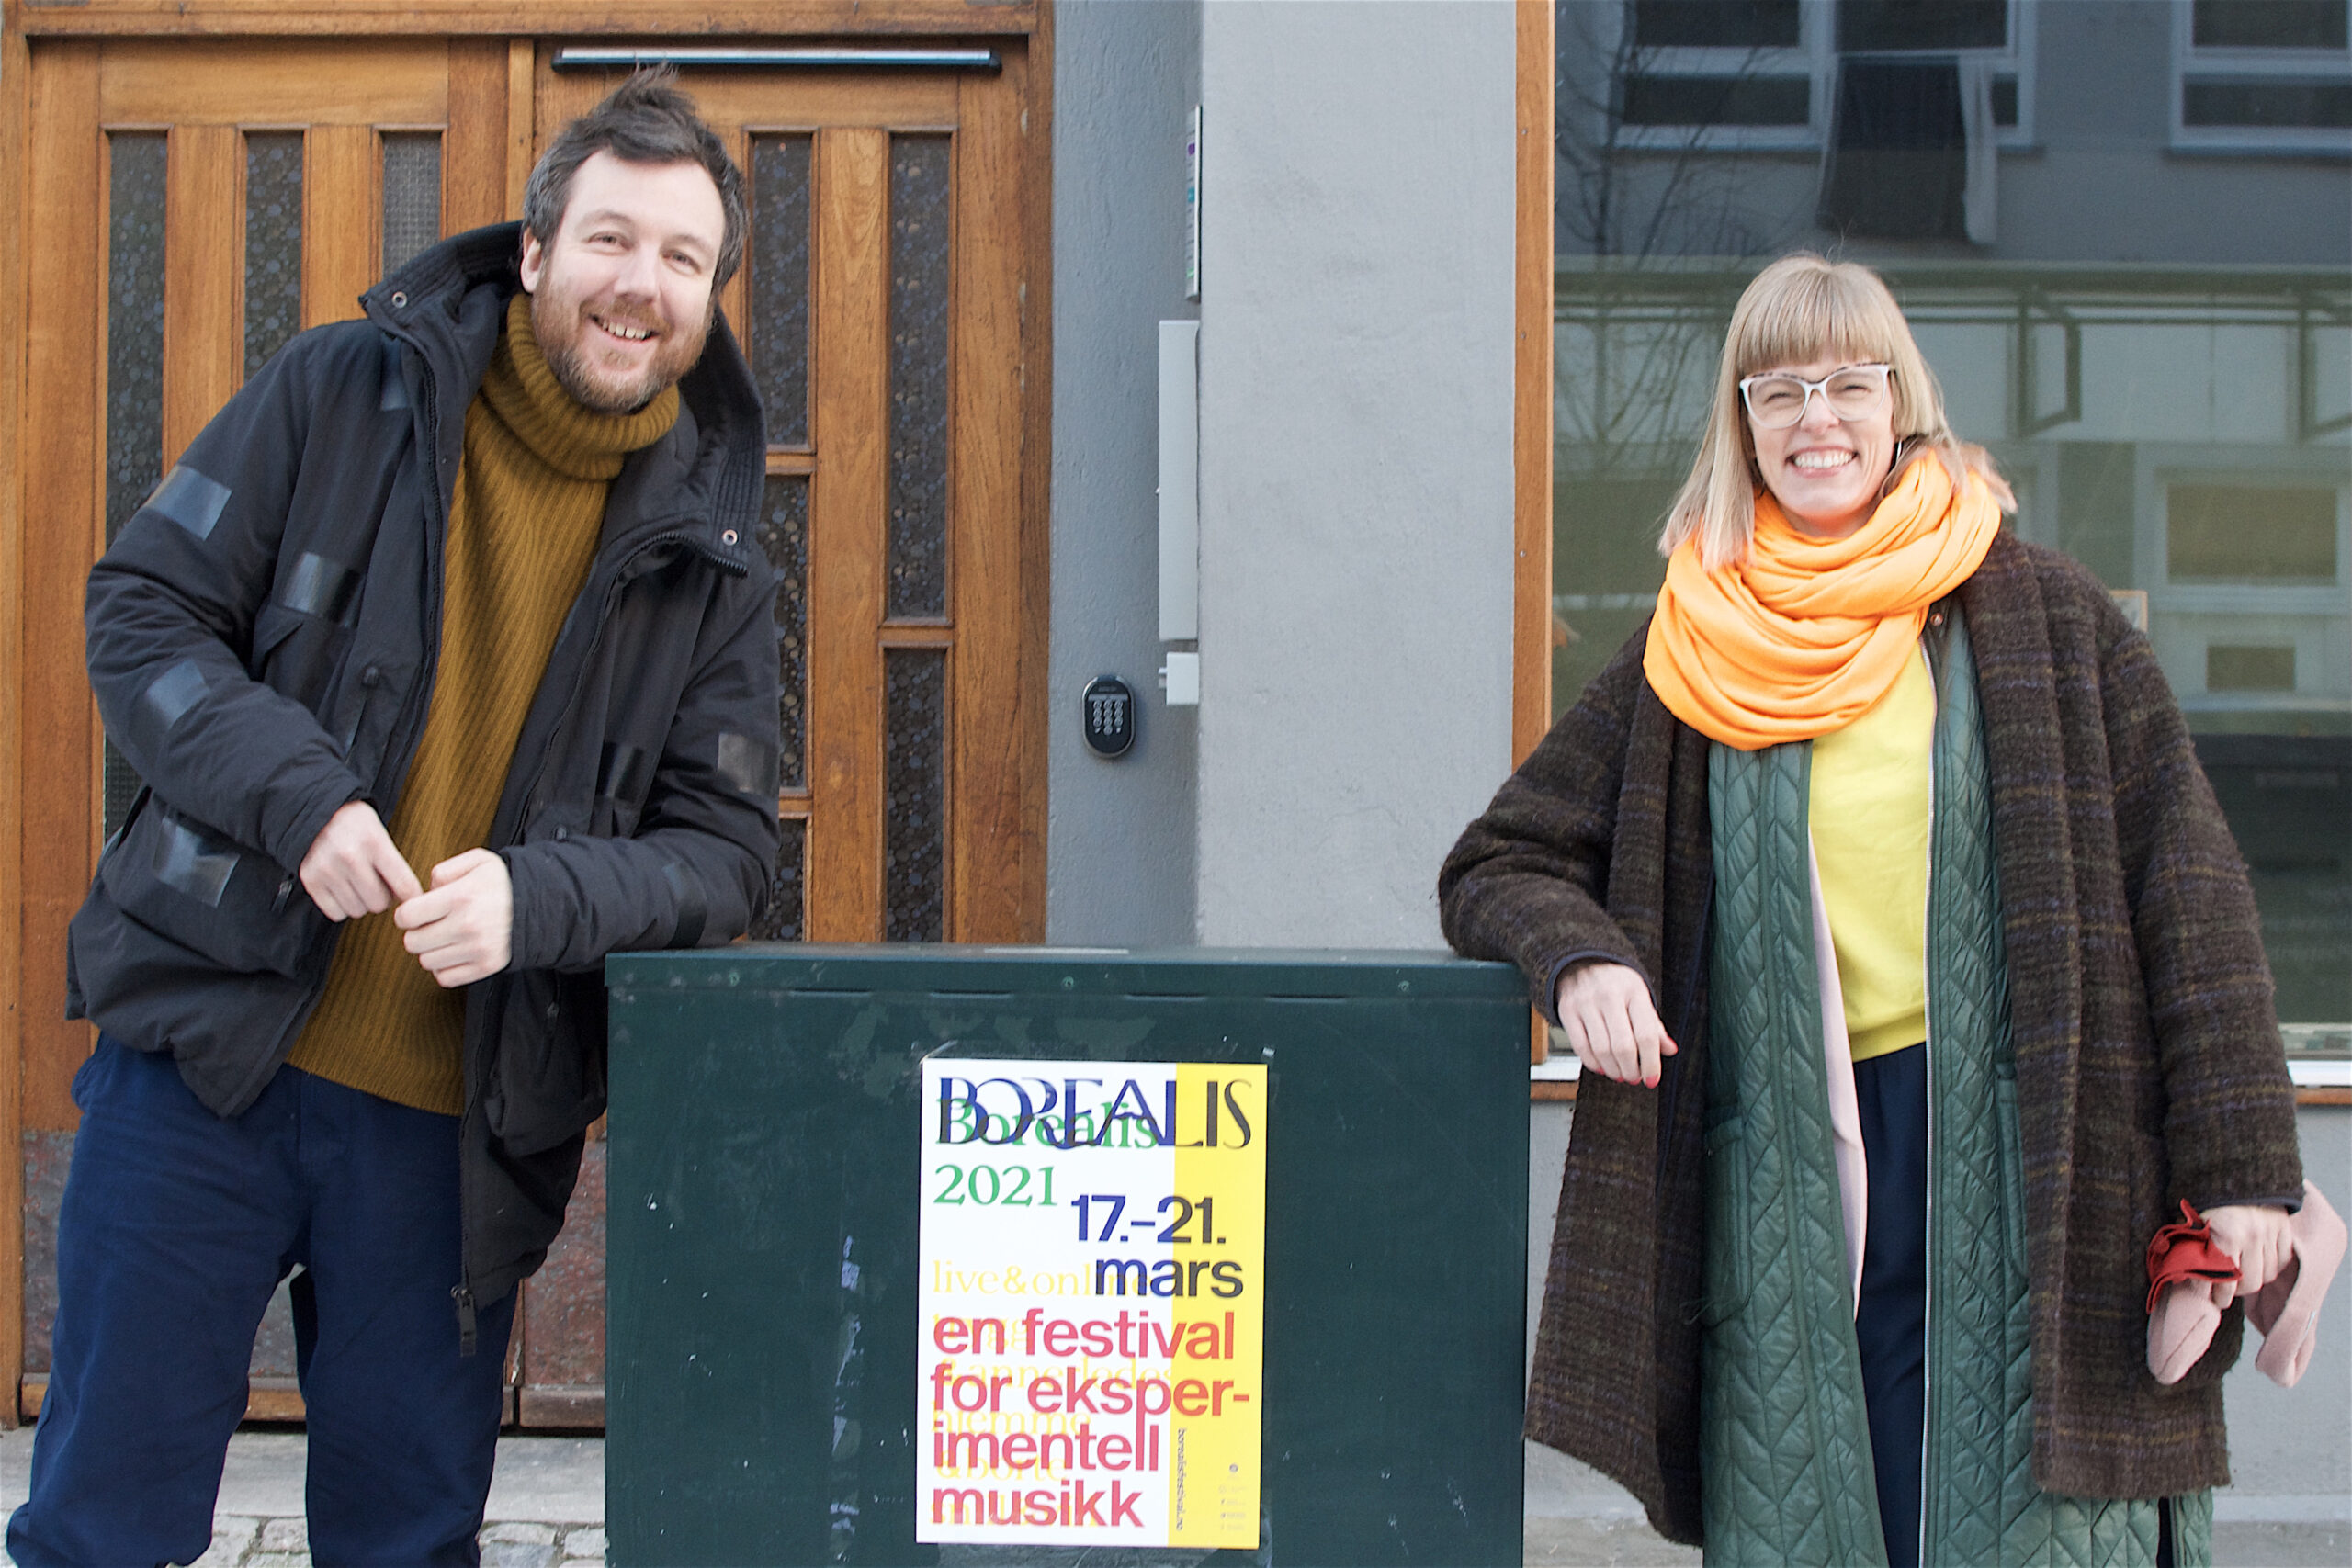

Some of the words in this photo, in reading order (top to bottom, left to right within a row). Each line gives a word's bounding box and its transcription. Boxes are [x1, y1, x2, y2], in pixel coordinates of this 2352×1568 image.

[935, 1098, 1158, 1149] Borealis
[939, 1077, 1252, 1150] BOREALIS
[933, 1164, 1058, 1207] 2021
[1094, 1258, 1245, 1299] mars
[933, 1315, 1007, 1356] en
[1022, 1307, 1235, 1360] festival
[930, 1362, 1012, 1413] for
[1027, 1366, 1250, 1427] eksper-
[933, 1421, 1159, 1472] imentell
[932, 1479, 1146, 1529] musikk
